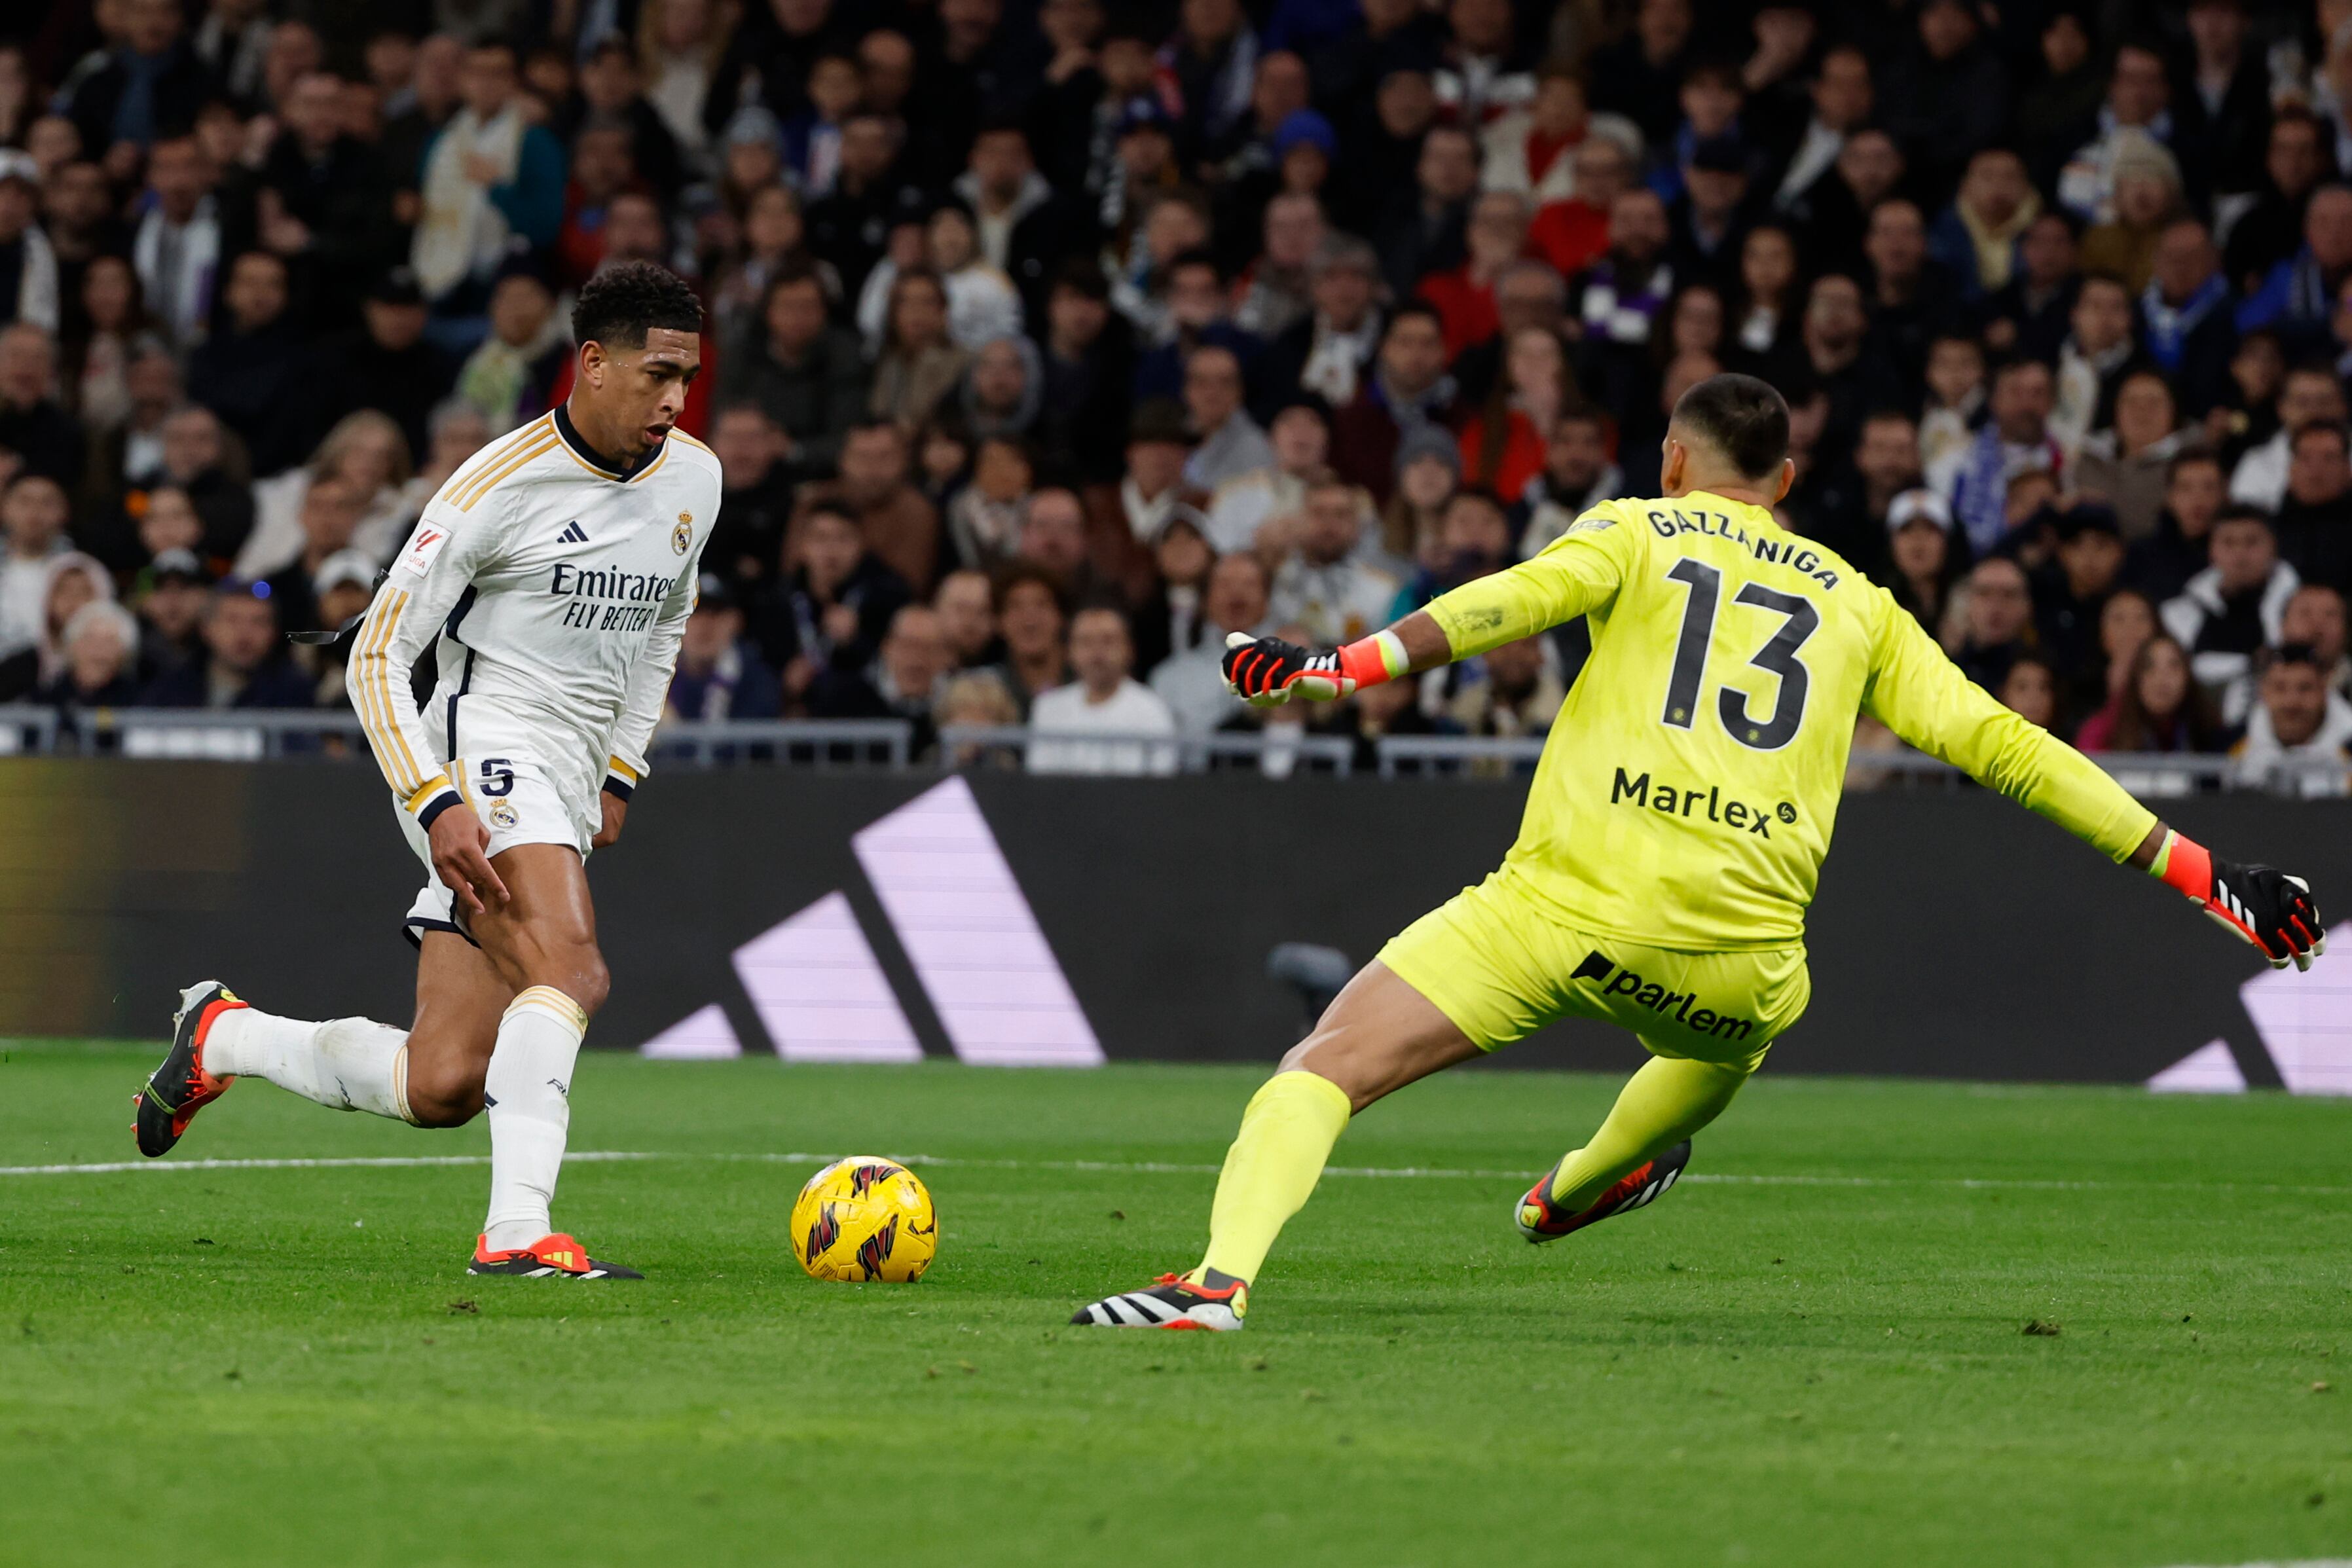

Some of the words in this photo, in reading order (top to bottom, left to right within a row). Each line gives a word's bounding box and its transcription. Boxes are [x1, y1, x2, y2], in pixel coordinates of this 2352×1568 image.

[551, 563, 676, 602] Emirates
[1647, 509, 1839, 591] GAZZANIGA
[562, 602, 600, 629] FLY
[600, 606, 653, 632] BETTER
[1661, 556, 1821, 750] 13
[479, 758, 514, 796] 5
[1610, 767, 1771, 840] Marlex
[1602, 970, 1753, 1041] parlem
